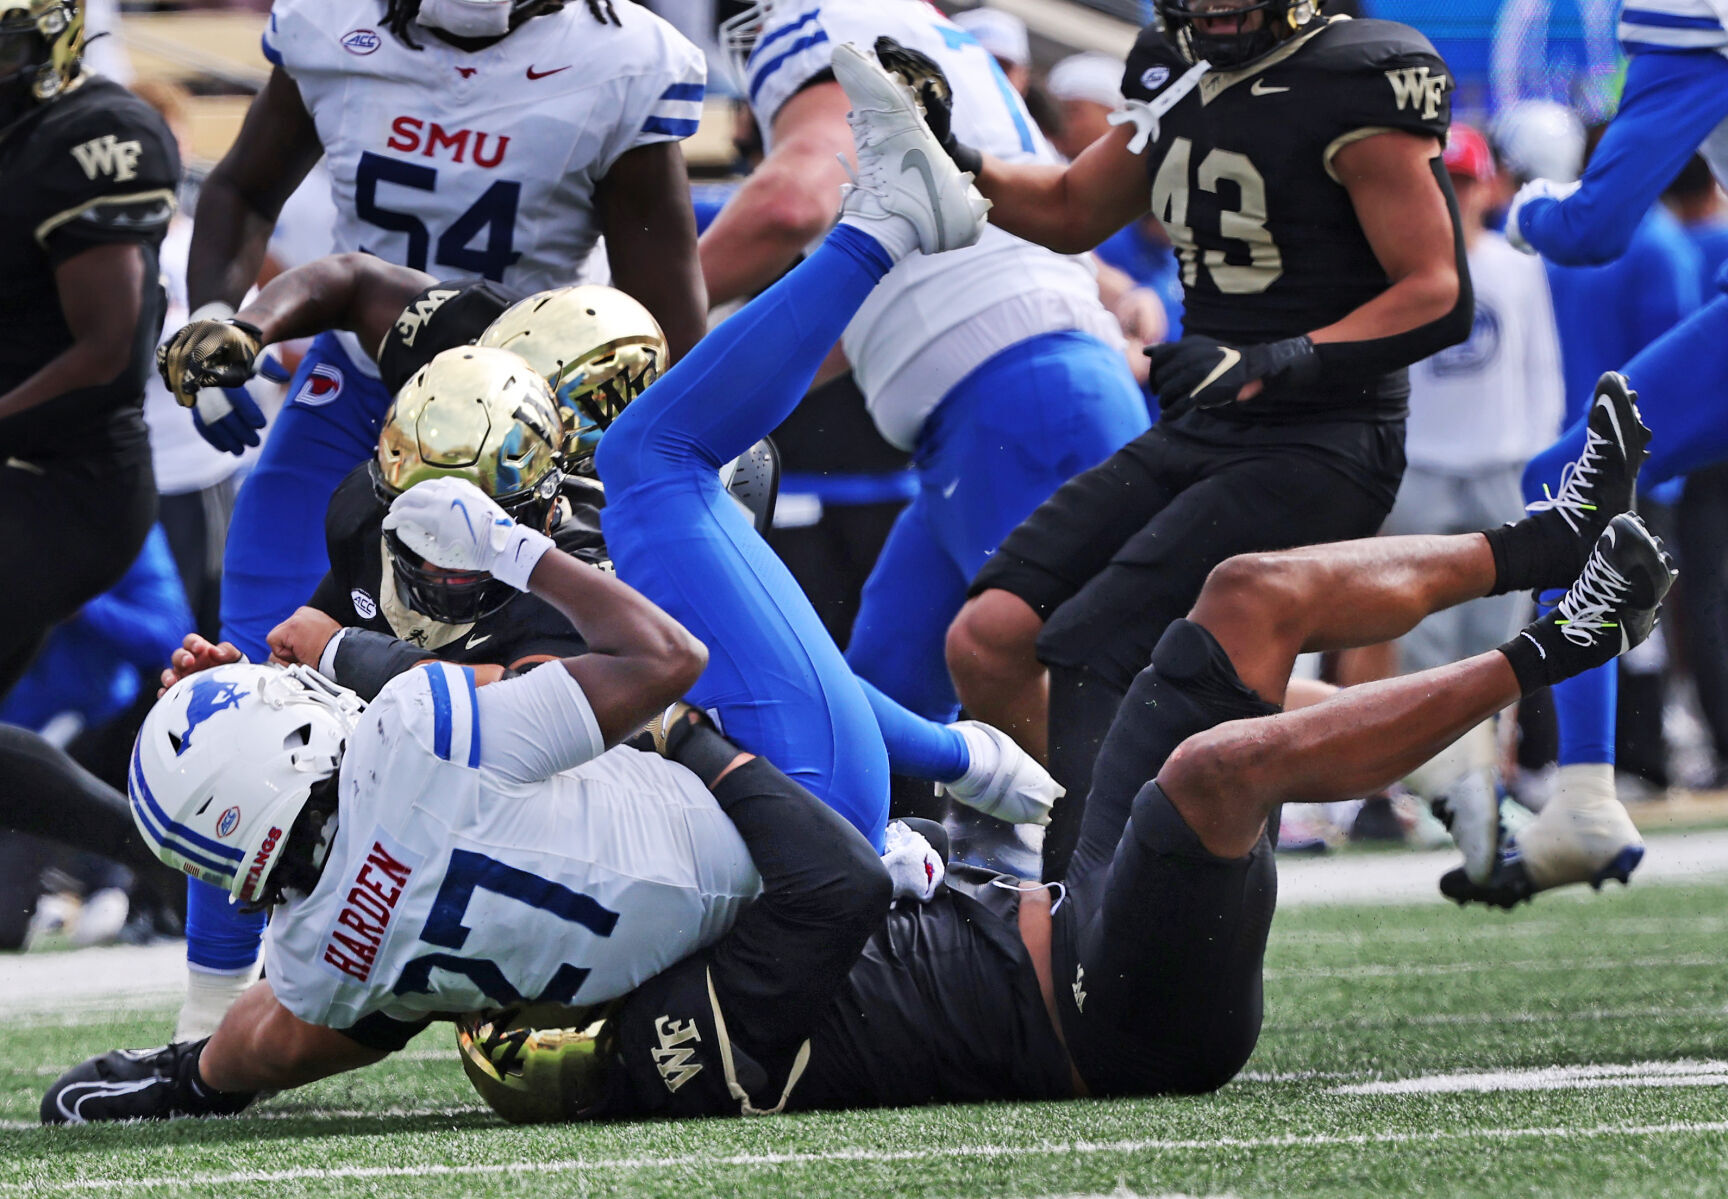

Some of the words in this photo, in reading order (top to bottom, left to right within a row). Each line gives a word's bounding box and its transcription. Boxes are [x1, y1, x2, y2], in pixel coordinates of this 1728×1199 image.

[1384, 66, 1446, 119] WF
[70, 134, 143, 183] WF
[387, 116, 511, 168] SMU
[355, 151, 522, 283] 54
[1151, 136, 1284, 294] 43
[395, 289, 461, 348] WF
[354, 595, 376, 615] ACC
[324, 841, 412, 983] HARDEN
[392, 848, 620, 1008] 27
[651, 1015, 703, 1093] WF
